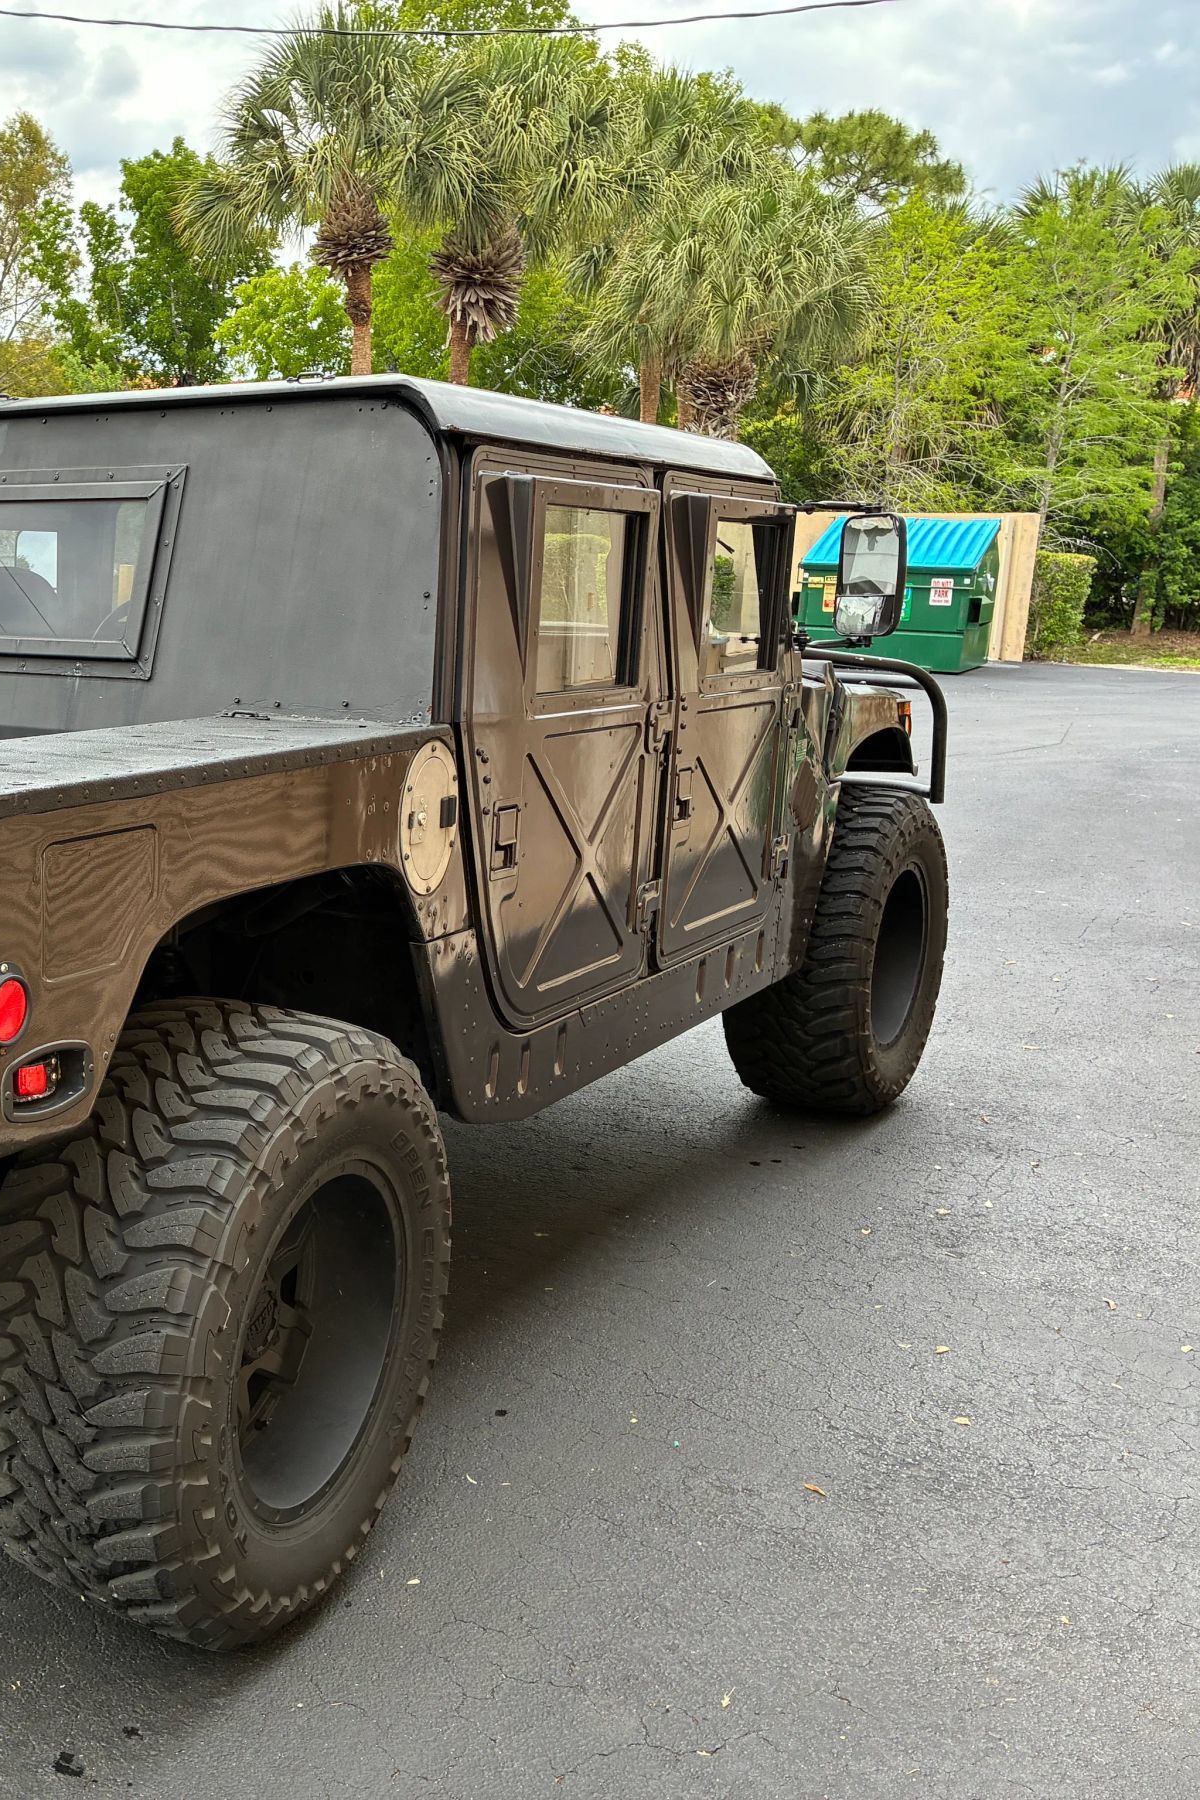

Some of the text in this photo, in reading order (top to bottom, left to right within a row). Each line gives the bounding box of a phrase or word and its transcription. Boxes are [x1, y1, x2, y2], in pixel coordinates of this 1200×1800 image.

[933, 589, 949, 598] PARK
[385, 1128, 437, 1451] OPEN COUNTRY
[218, 1422, 249, 1559] TOYO
